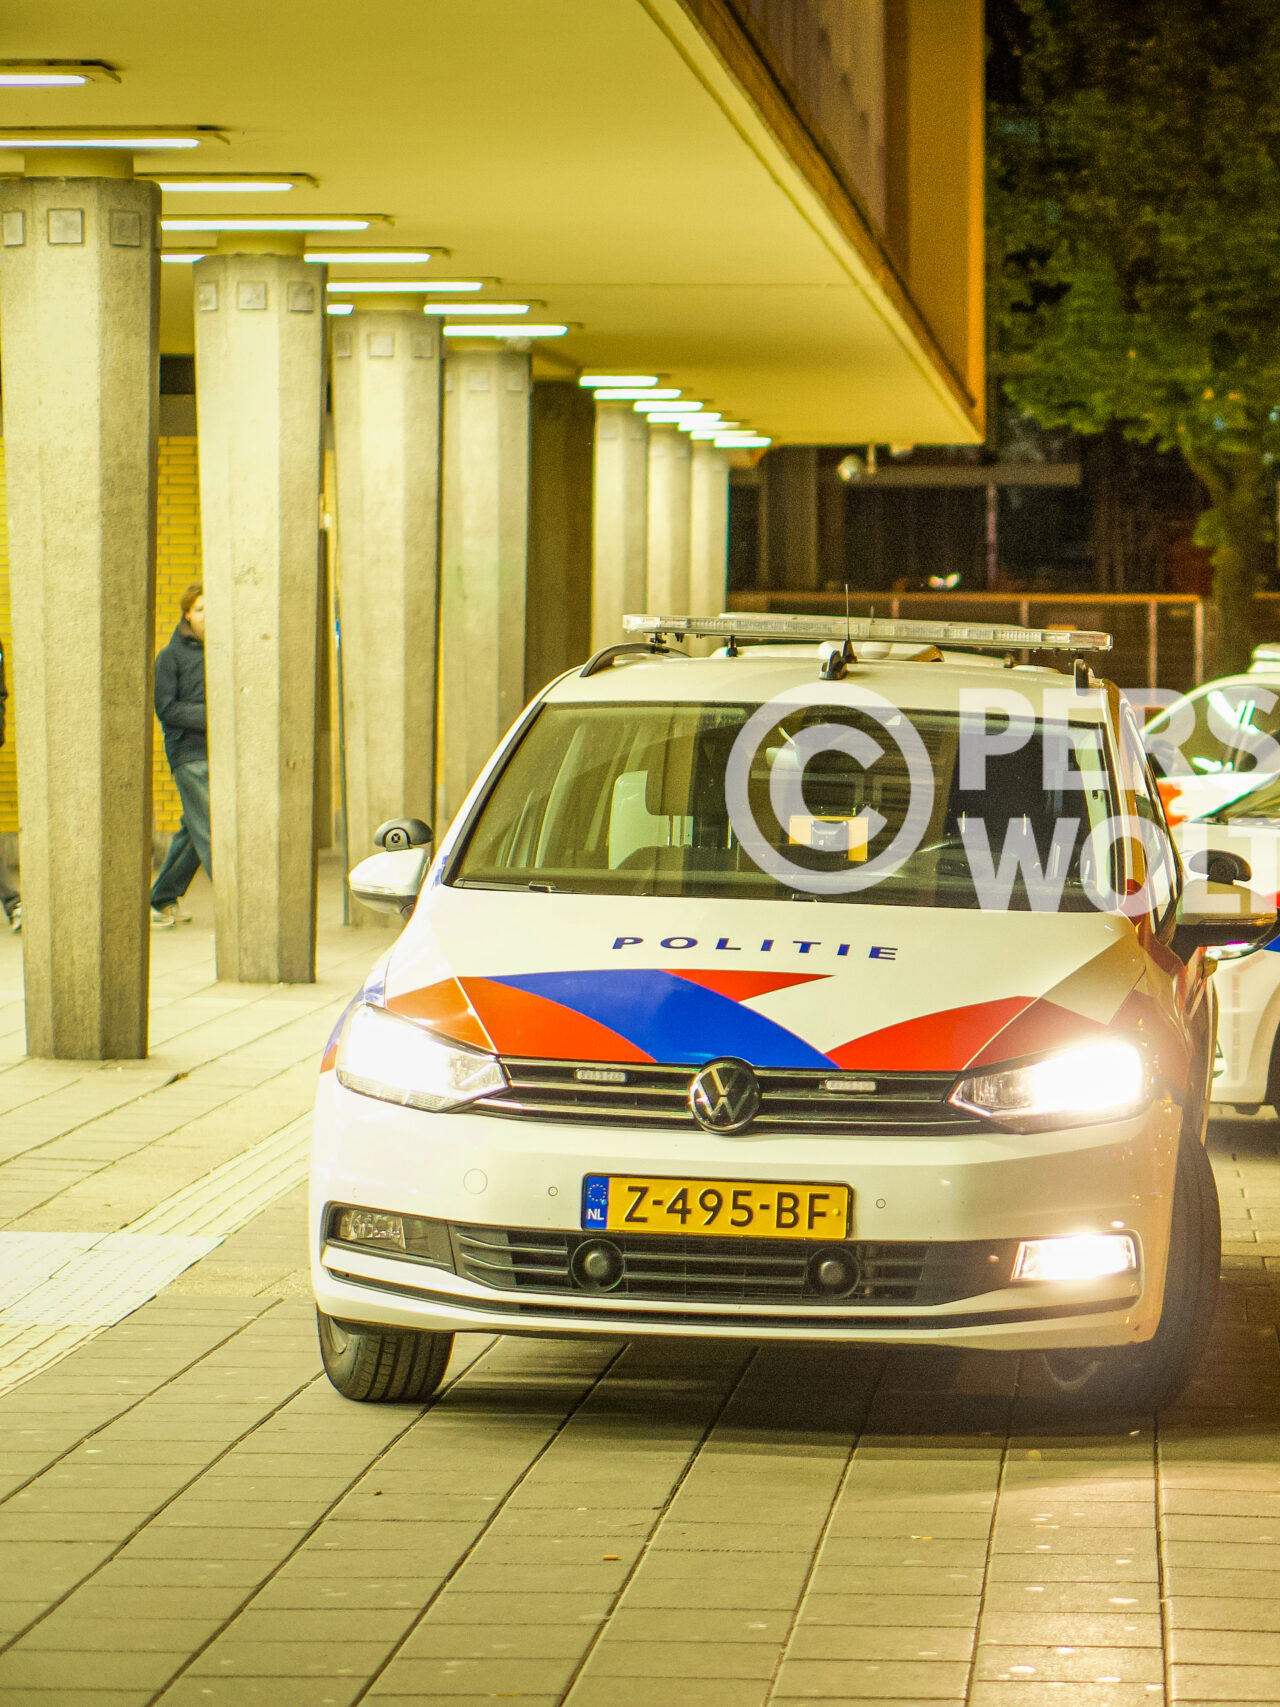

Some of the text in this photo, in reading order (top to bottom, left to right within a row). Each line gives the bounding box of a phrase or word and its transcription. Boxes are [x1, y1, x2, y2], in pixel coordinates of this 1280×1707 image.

[612, 936, 899, 961] POLITIE
[587, 1208, 604, 1221] NL
[624, 1185, 831, 1230] Z-495-BF
